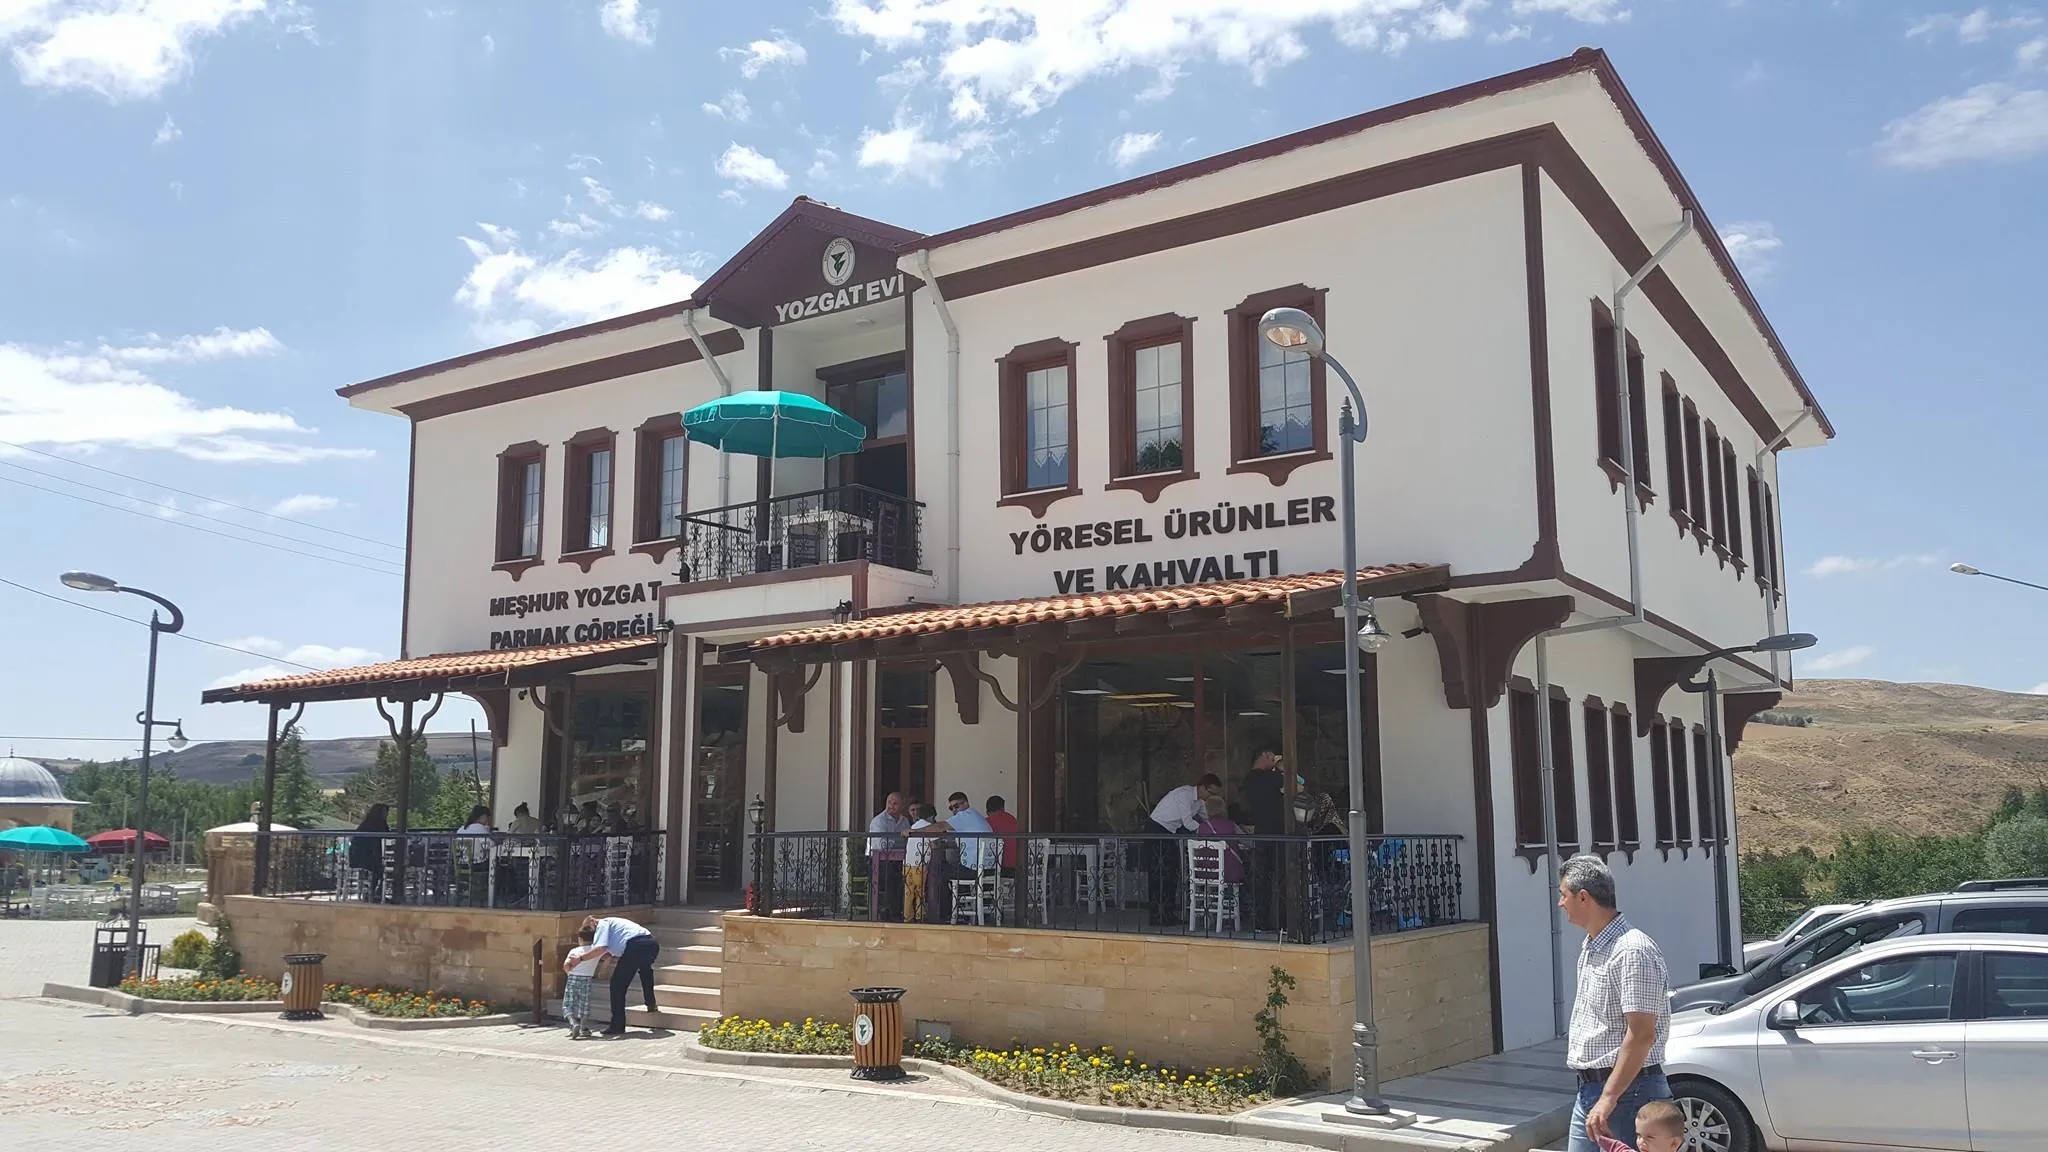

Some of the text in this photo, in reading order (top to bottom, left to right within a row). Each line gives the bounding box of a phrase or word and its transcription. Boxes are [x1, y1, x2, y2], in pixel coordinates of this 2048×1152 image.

[775, 284, 863, 322] YOZGAT
[1009, 495, 1336, 555] YÖRESEL ÜRÜNLER
[1054, 549, 1279, 594] VE KAHVALTI
[490, 581, 662, 619] MEŞHUR YOZGAT
[490, 626, 570, 650] PARMAK
